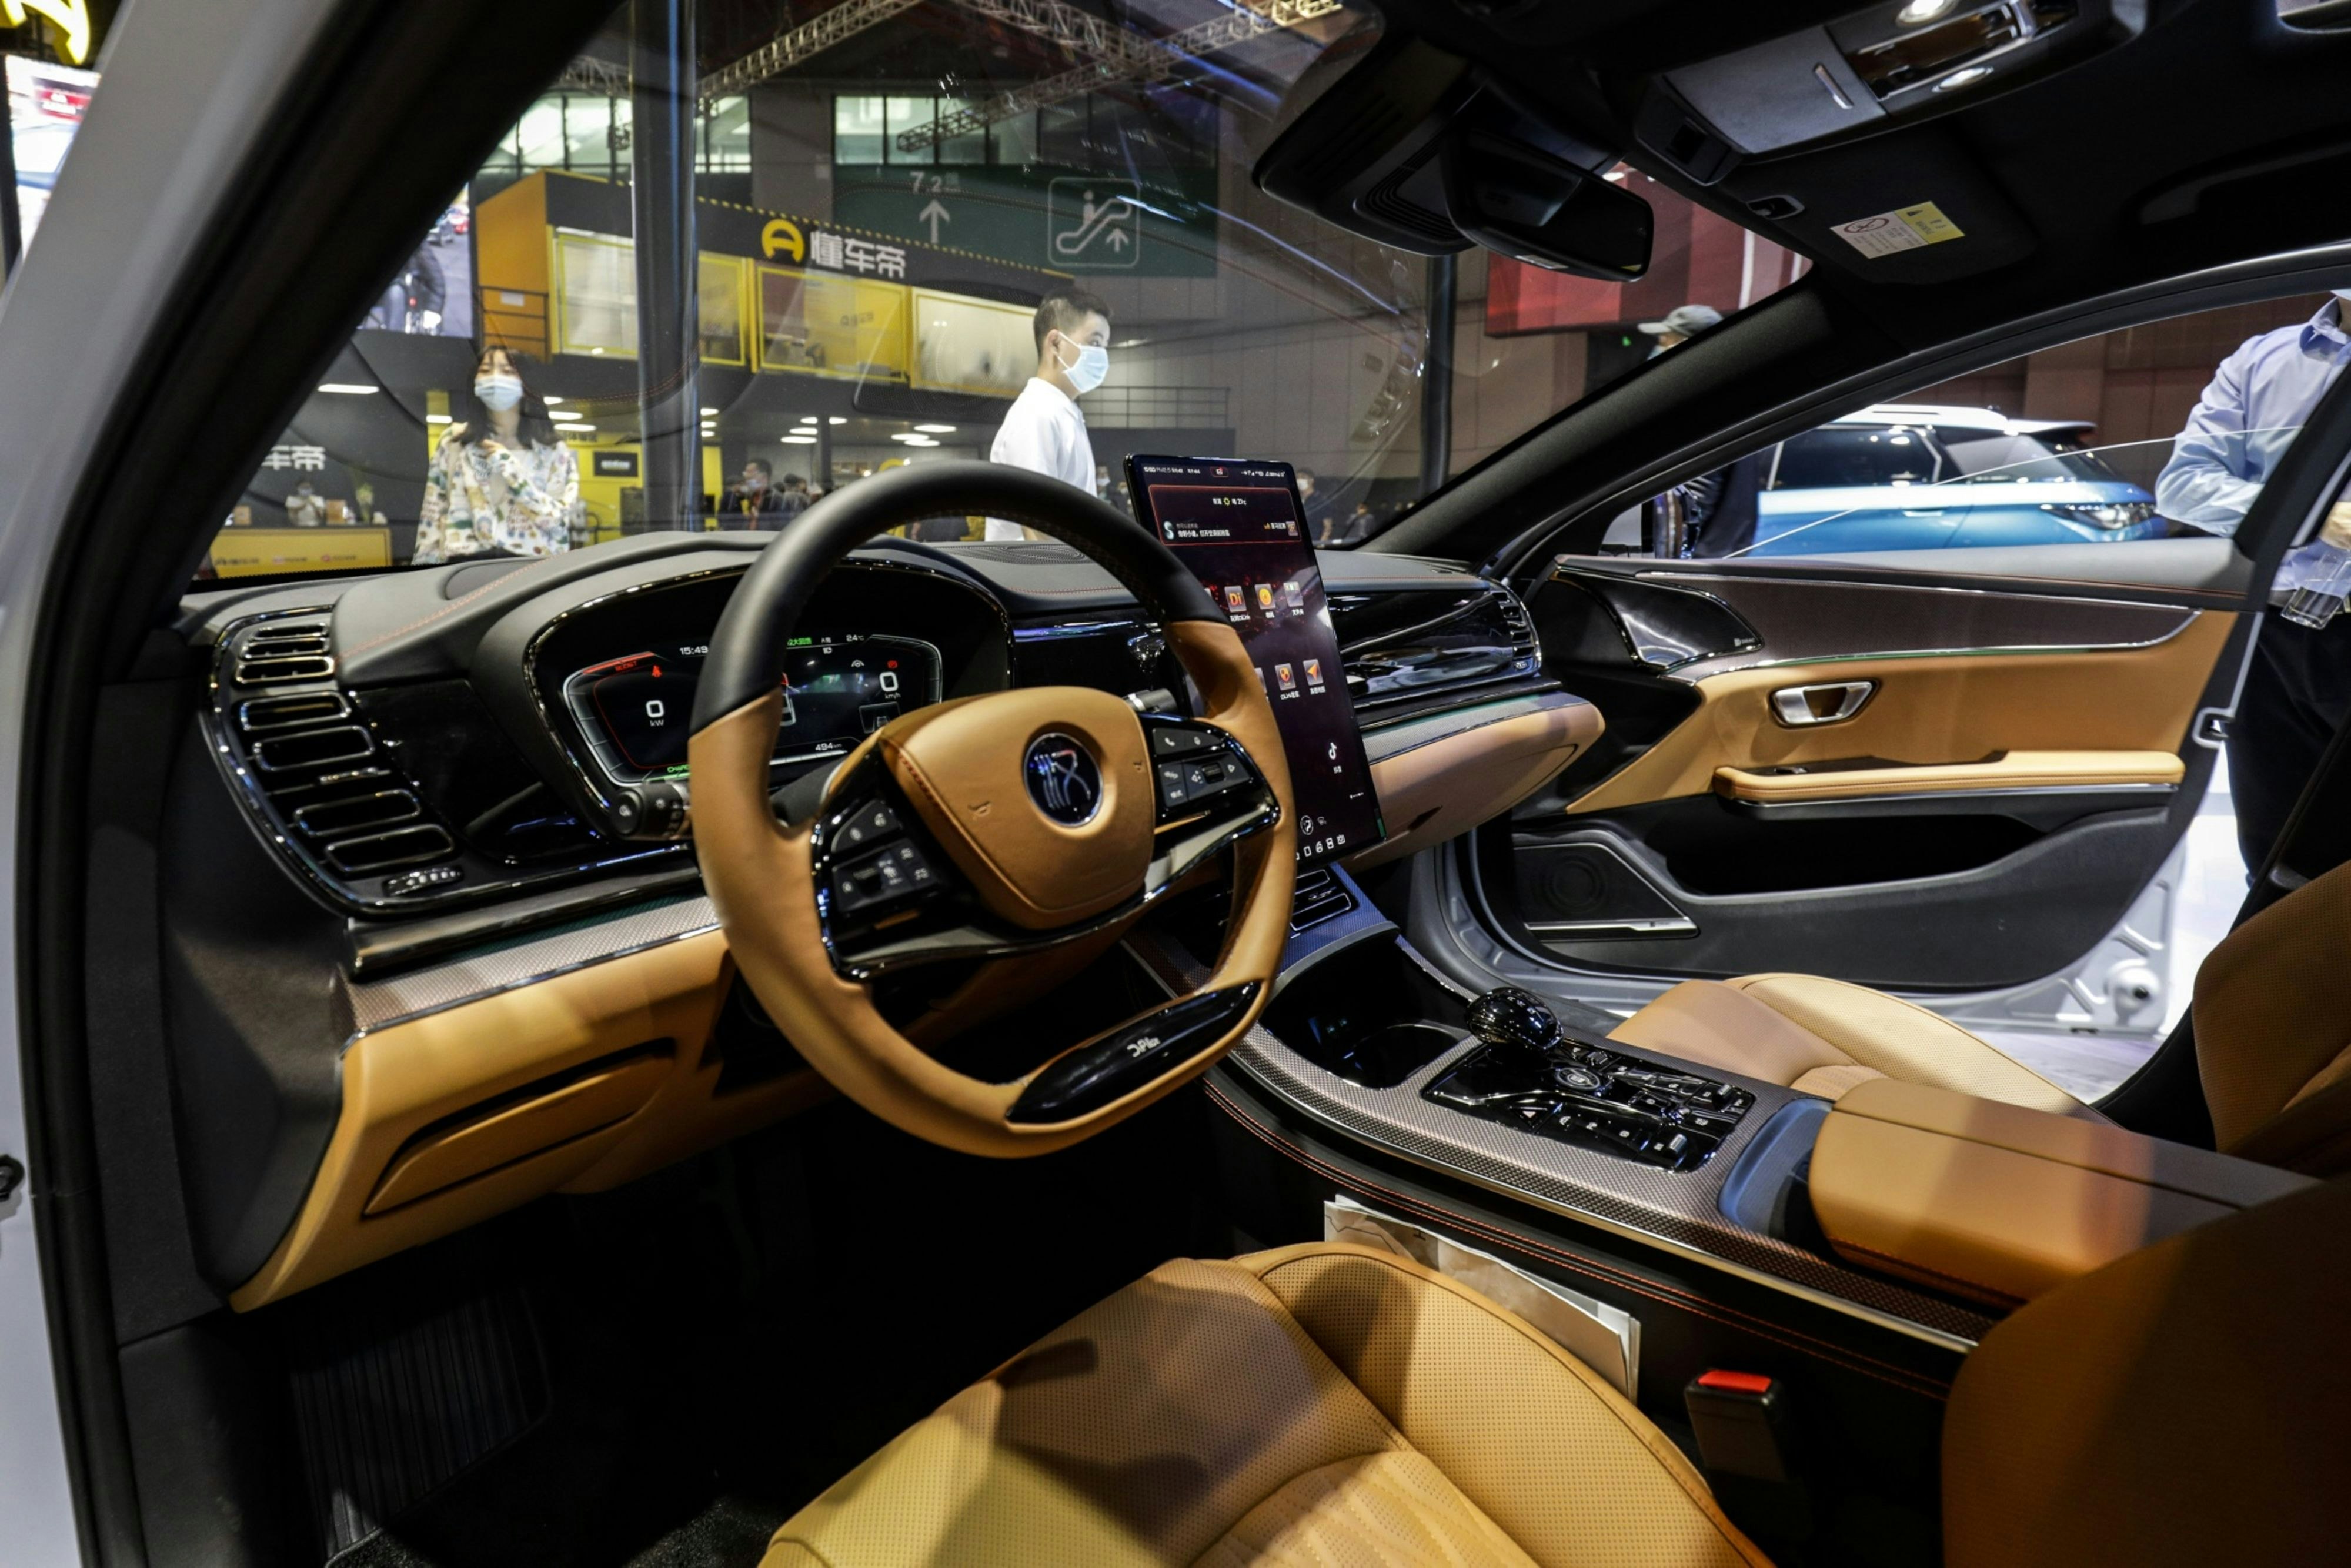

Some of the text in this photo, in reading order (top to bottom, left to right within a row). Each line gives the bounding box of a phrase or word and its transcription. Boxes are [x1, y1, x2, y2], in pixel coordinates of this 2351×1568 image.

[810, 230, 906, 279] 懂车帝
[1229, 592, 1243, 606] Di
[679, 646, 709, 656] 15:49
[880, 672, 899, 692] 0
[646, 700, 664, 718] 0
